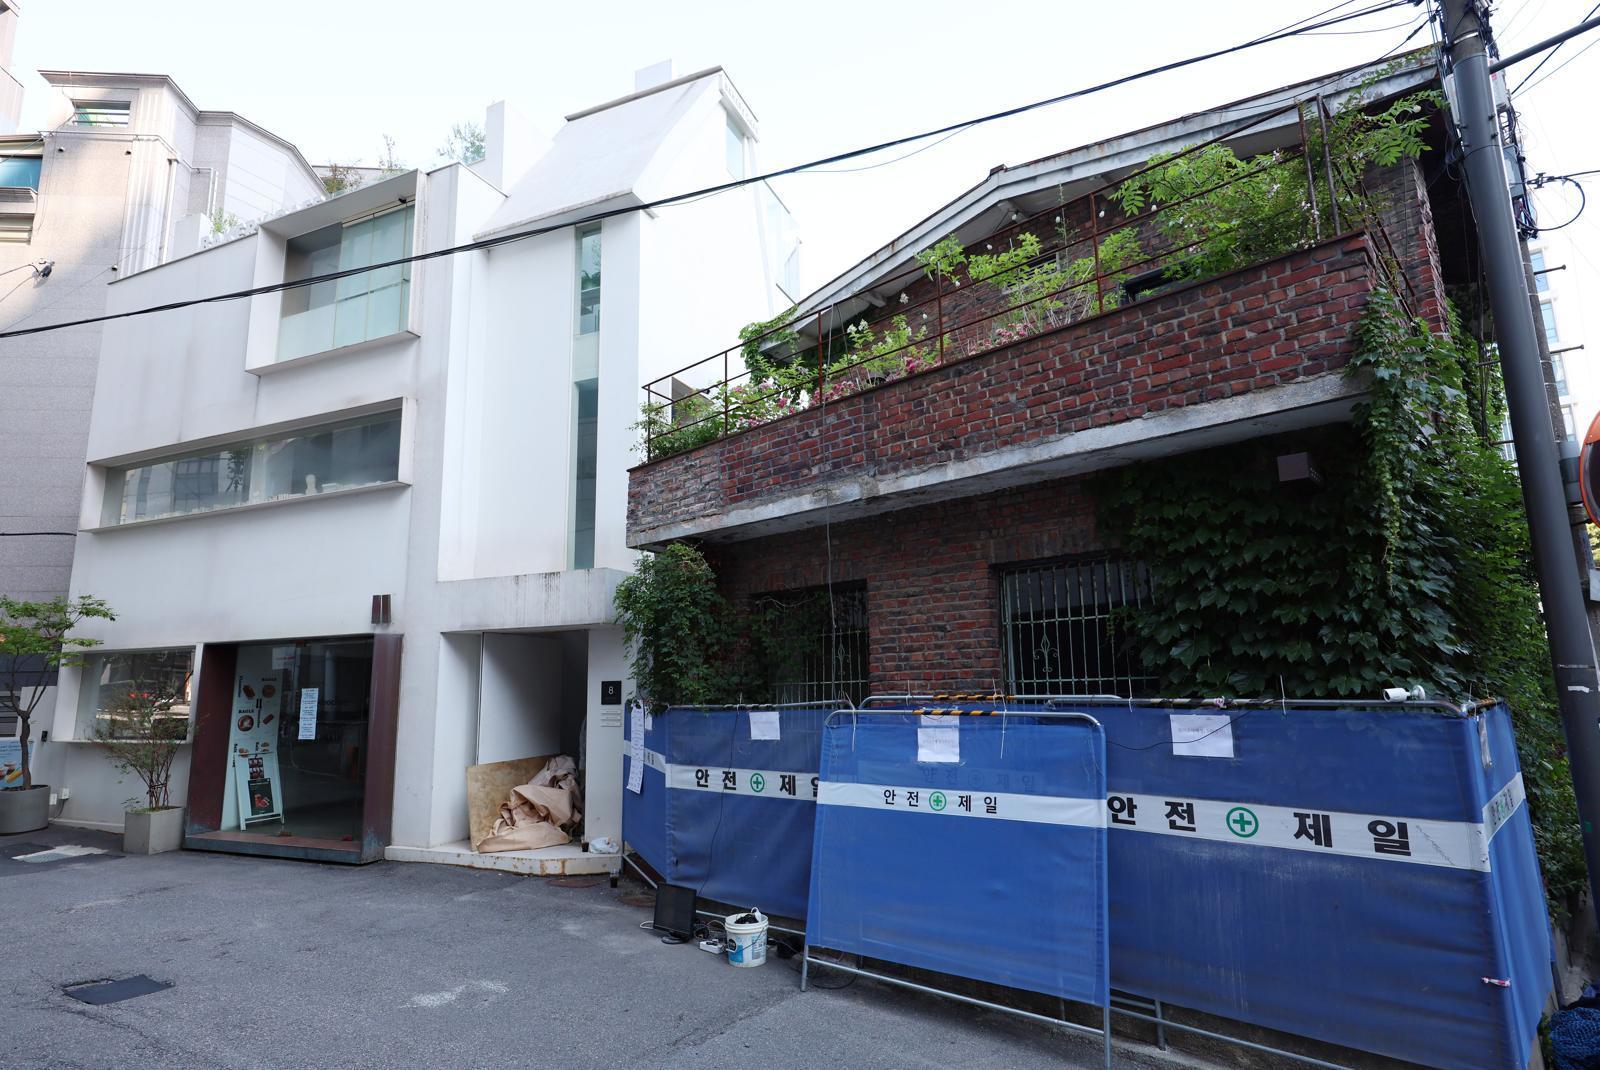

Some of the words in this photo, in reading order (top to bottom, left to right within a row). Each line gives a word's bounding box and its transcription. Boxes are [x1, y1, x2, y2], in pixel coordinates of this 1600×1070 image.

[608, 686, 614, 695] 8
[695, 769, 737, 791] 안전
[883, 789, 919, 807] 안전
[958, 795, 998, 814] 제일
[1107, 796, 1196, 832] 안전
[1293, 812, 1412, 857] 제일
